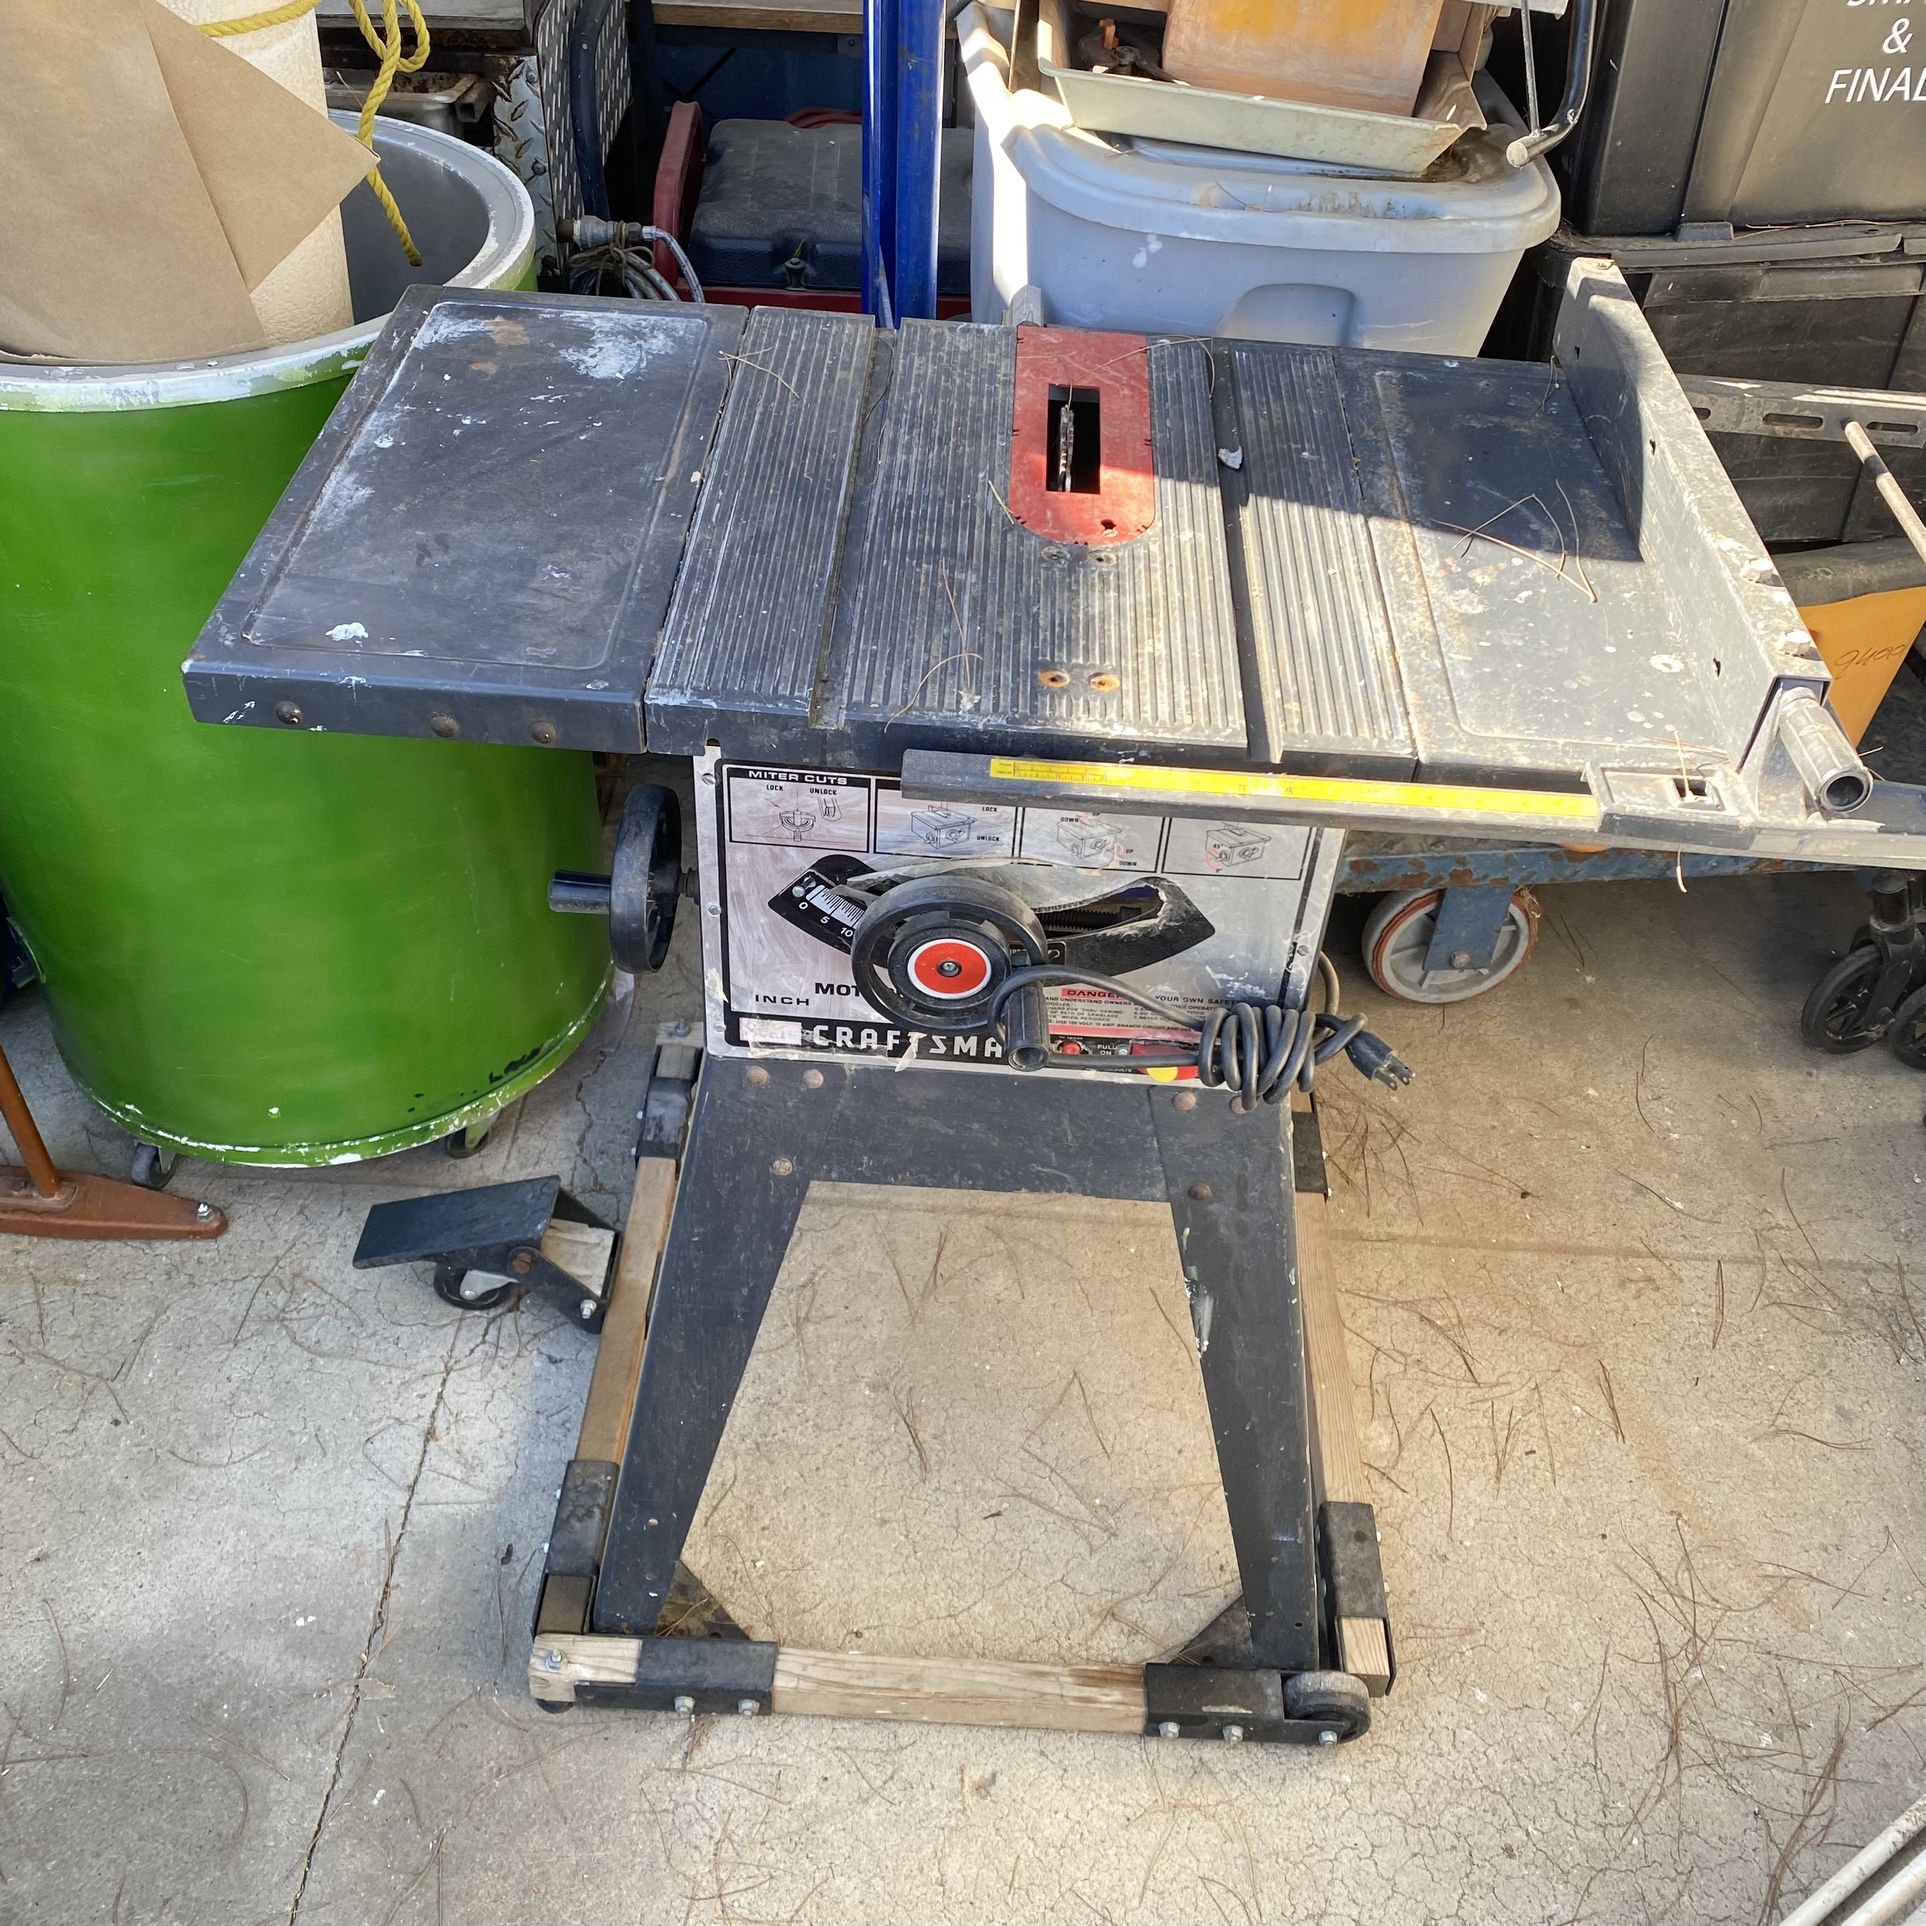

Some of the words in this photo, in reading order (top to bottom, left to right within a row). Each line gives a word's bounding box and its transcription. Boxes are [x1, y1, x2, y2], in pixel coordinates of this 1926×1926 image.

[1882, 17, 1914, 54] &
[749, 770, 799, 781] MITER
[804, 775, 848, 785] CUTS
[809, 788, 837, 796] UNLOCK
[798, 901, 809, 910] 0
[820, 915, 830, 924] 5
[840, 927, 854, 938] 10
[1066, 989, 1121, 999] DANGE
[755, 994, 810, 1006] INCH
[812, 1024, 1005, 1058] CRAFTSMA
